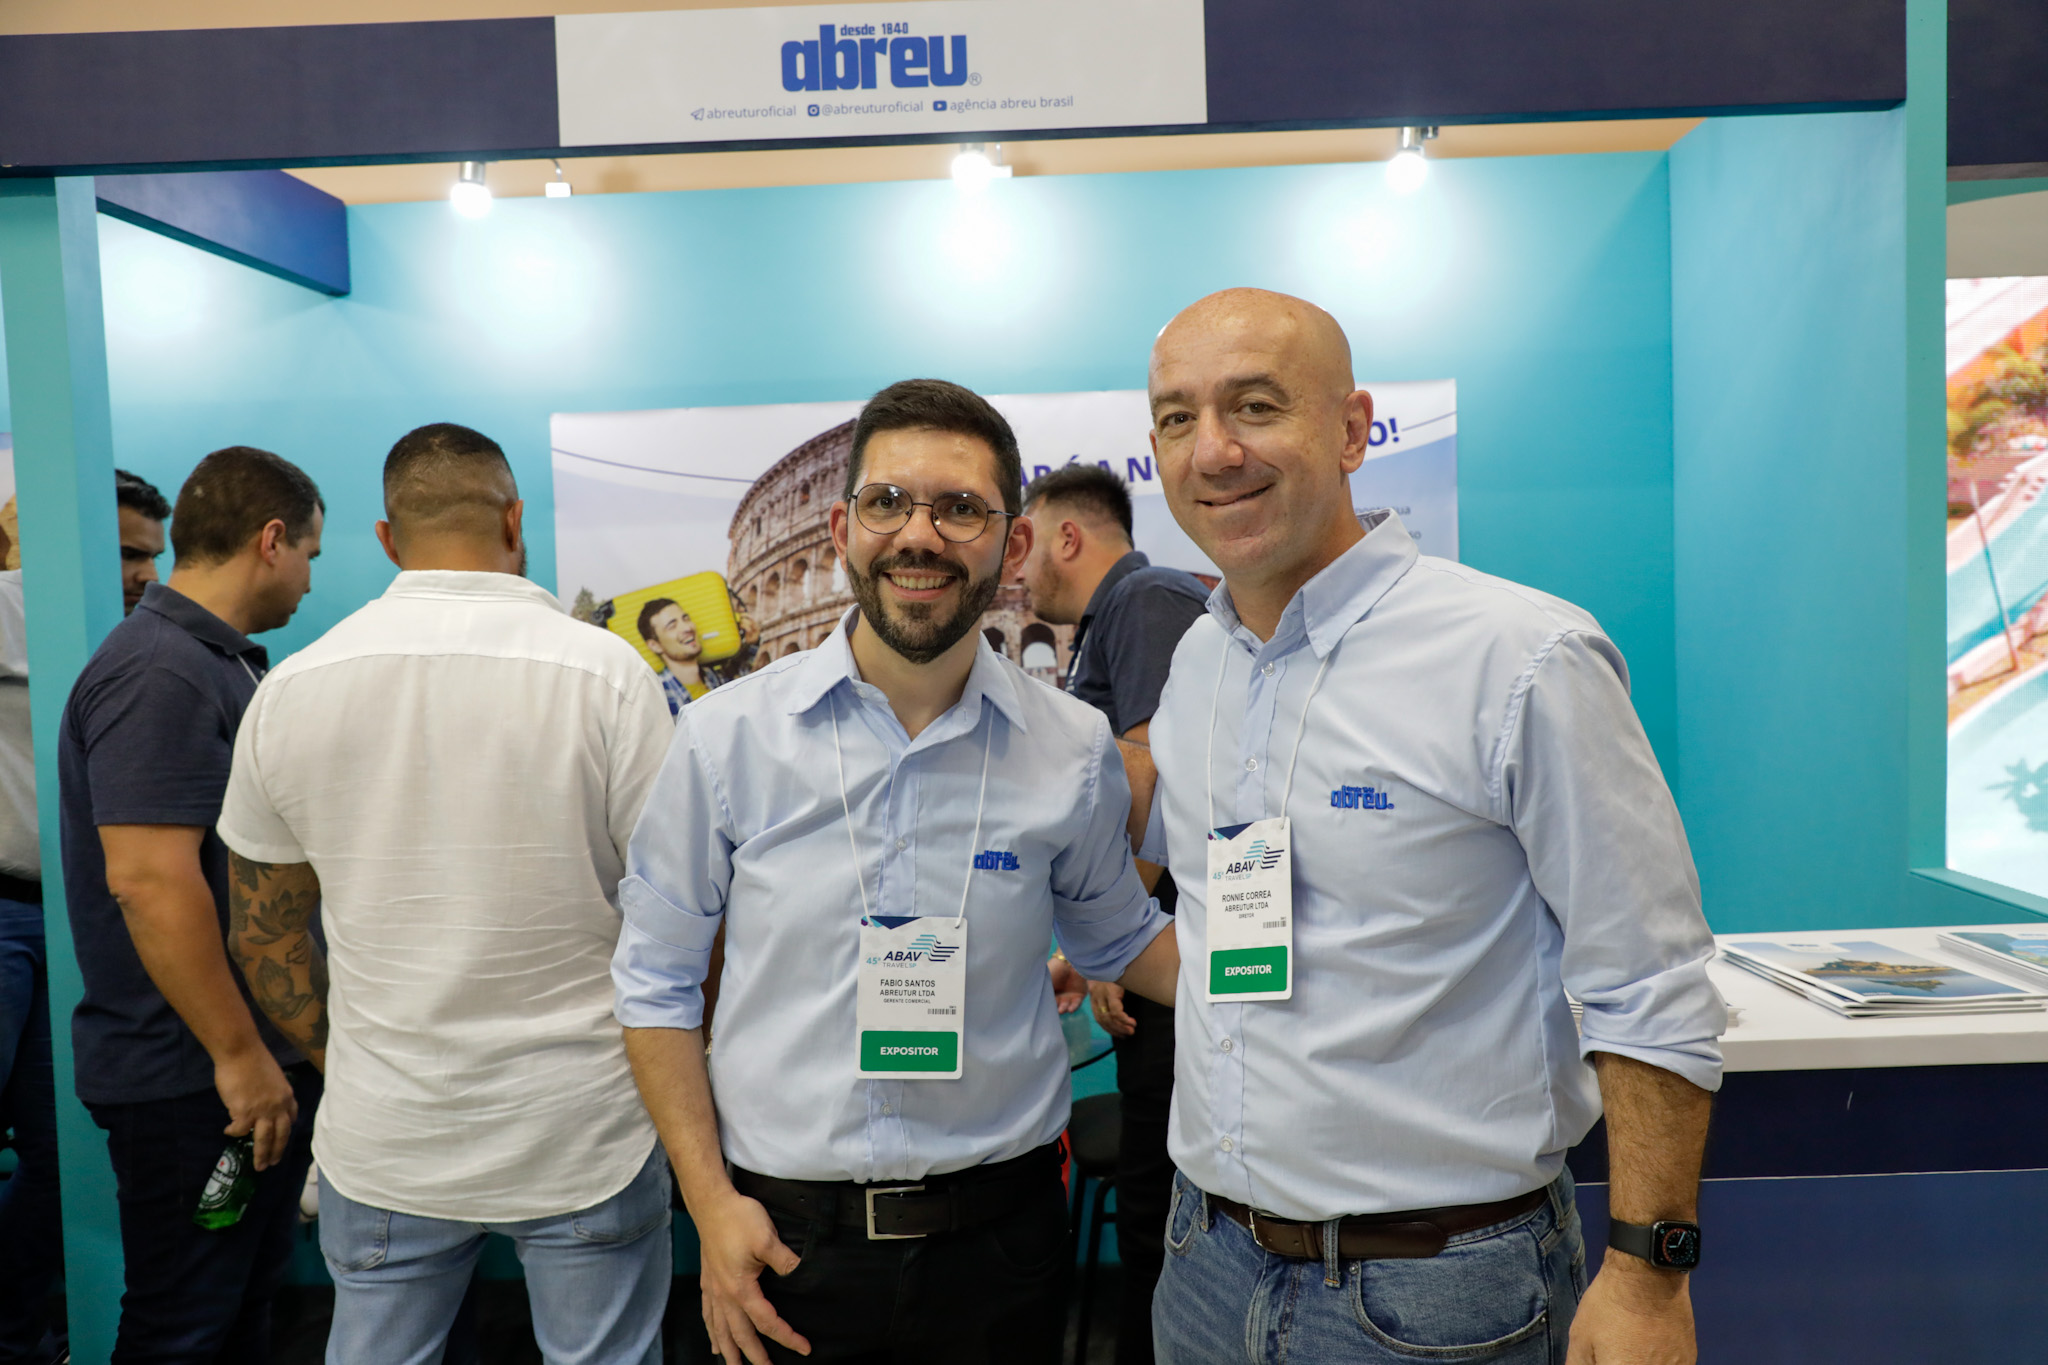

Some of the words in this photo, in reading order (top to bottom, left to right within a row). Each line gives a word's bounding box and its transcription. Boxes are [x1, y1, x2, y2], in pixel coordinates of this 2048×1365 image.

[840, 24, 875, 36] desde
[882, 22, 909, 35] 1840
[821, 102, 924, 117] @abreuturoficial
[950, 99, 997, 113] agência
[1000, 97, 1037, 110] abreu
[1040, 95, 1074, 108] brasil
[707, 106, 796, 119] abreuturoficial
[1225, 859, 1256, 875] ABAV
[1222, 892, 1245, 903] RONNIE
[1245, 890, 1272, 901] CORREA
[1224, 902, 1254, 912] ABREUTUR
[1255, 901, 1269, 910] LTDA
[883, 950, 923, 962] ABAV
[1224, 964, 1272, 977] EXPOSITOR
[880, 979, 903, 987] FABIO
[904, 979, 936, 988] SANTOS
[880, 989, 917, 997] ABREUTUR
[880, 1046, 939, 1056] EXPOSITOR
